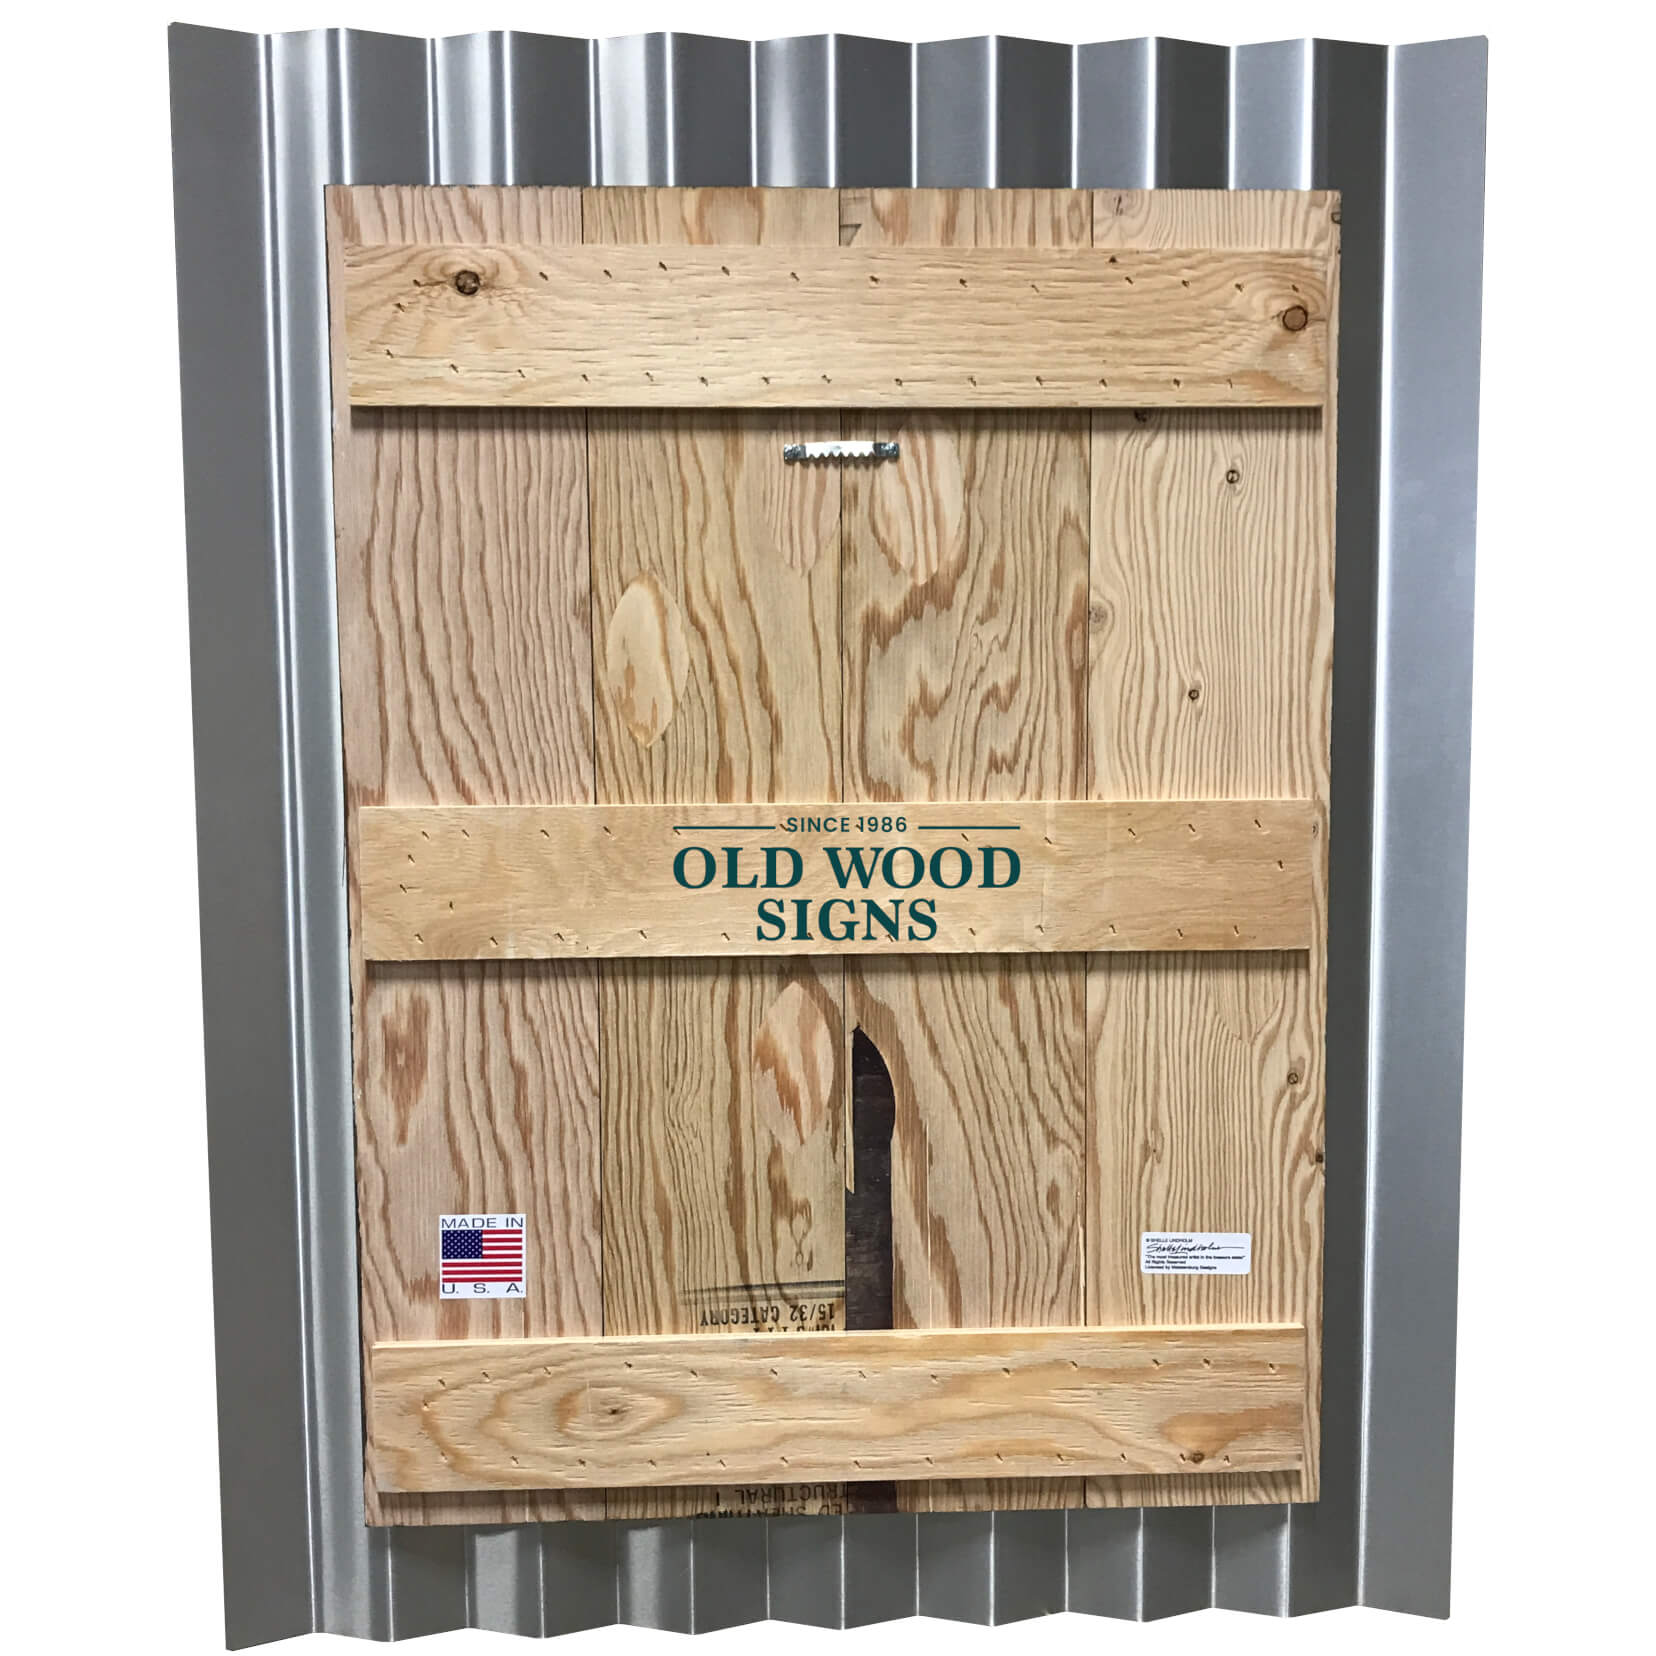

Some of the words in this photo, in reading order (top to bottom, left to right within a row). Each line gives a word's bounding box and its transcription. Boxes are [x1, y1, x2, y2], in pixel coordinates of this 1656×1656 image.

[787, 817, 850, 833] SINCE
[858, 816, 908, 833] 1986
[673, 846, 804, 889] OLD
[823, 846, 1021, 889] WOOD
[756, 898, 938, 942] SIGNS
[441, 1217, 497, 1229] MADE
[505, 1216, 524, 1228] IN
[442, 1283, 459, 1294] U.
[473, 1283, 490, 1294] S.
[506, 1282, 523, 1294] A.
[701, 1305, 780, 1326] CATEGORY
[789, 1303, 835, 1322] 15/32
